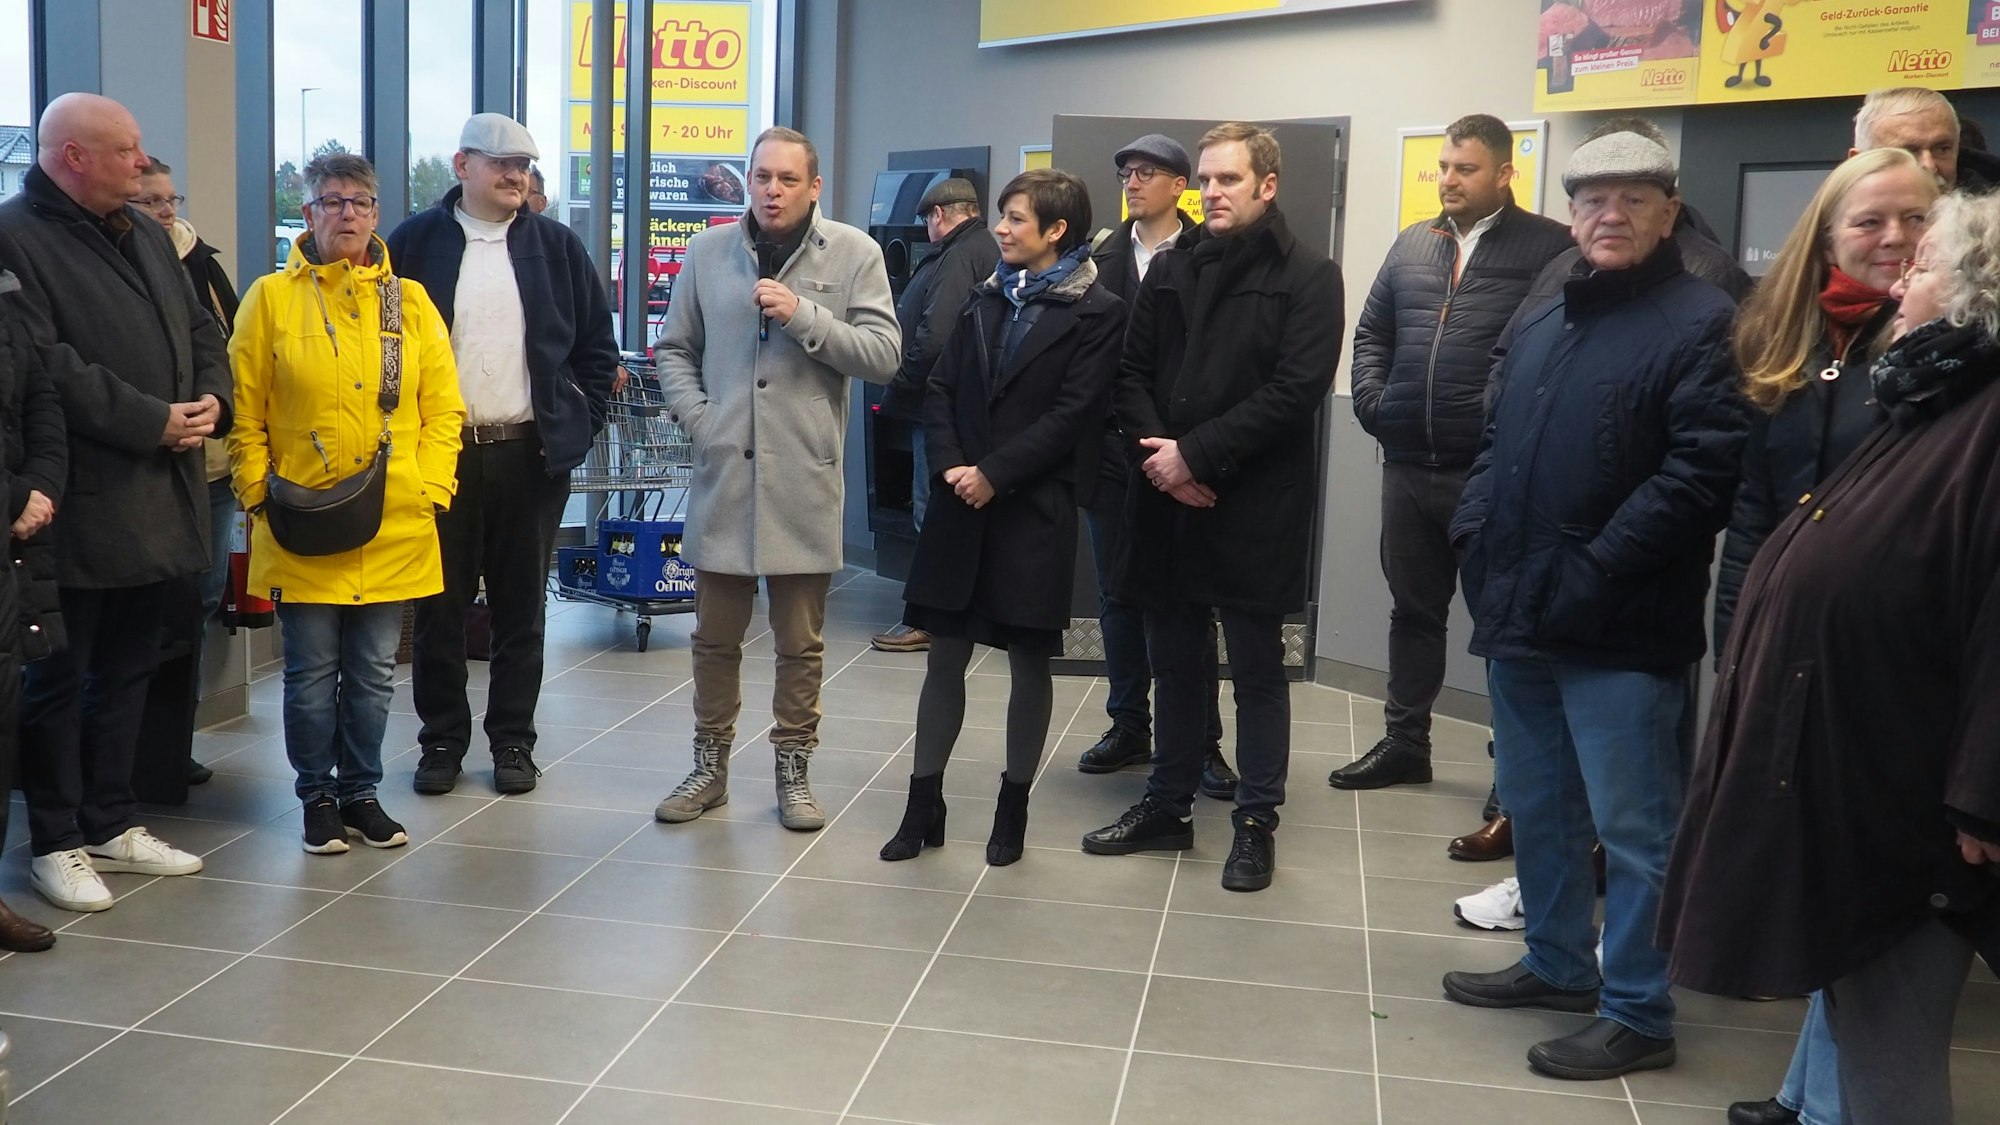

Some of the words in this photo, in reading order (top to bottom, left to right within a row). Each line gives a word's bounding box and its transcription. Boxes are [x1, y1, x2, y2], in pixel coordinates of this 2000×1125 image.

[1820, 3, 1929, 21] Geld-Zurück-Garantie
[1991, 6, 2000, 20] B
[579, 16, 741, 70] Ntto
[1575, 65, 1589, 73] zum
[1590, 61, 1615, 71] kleinen
[1888, 49, 1952, 72] Netto
[1641, 68, 1686, 87] Netto
[1903, 71, 1949, 79] Marken-Discount
[705, 126, 734, 139] Uhr
[650, 218, 707, 233] äckerei
[1763, 249, 1777, 260] Ku
